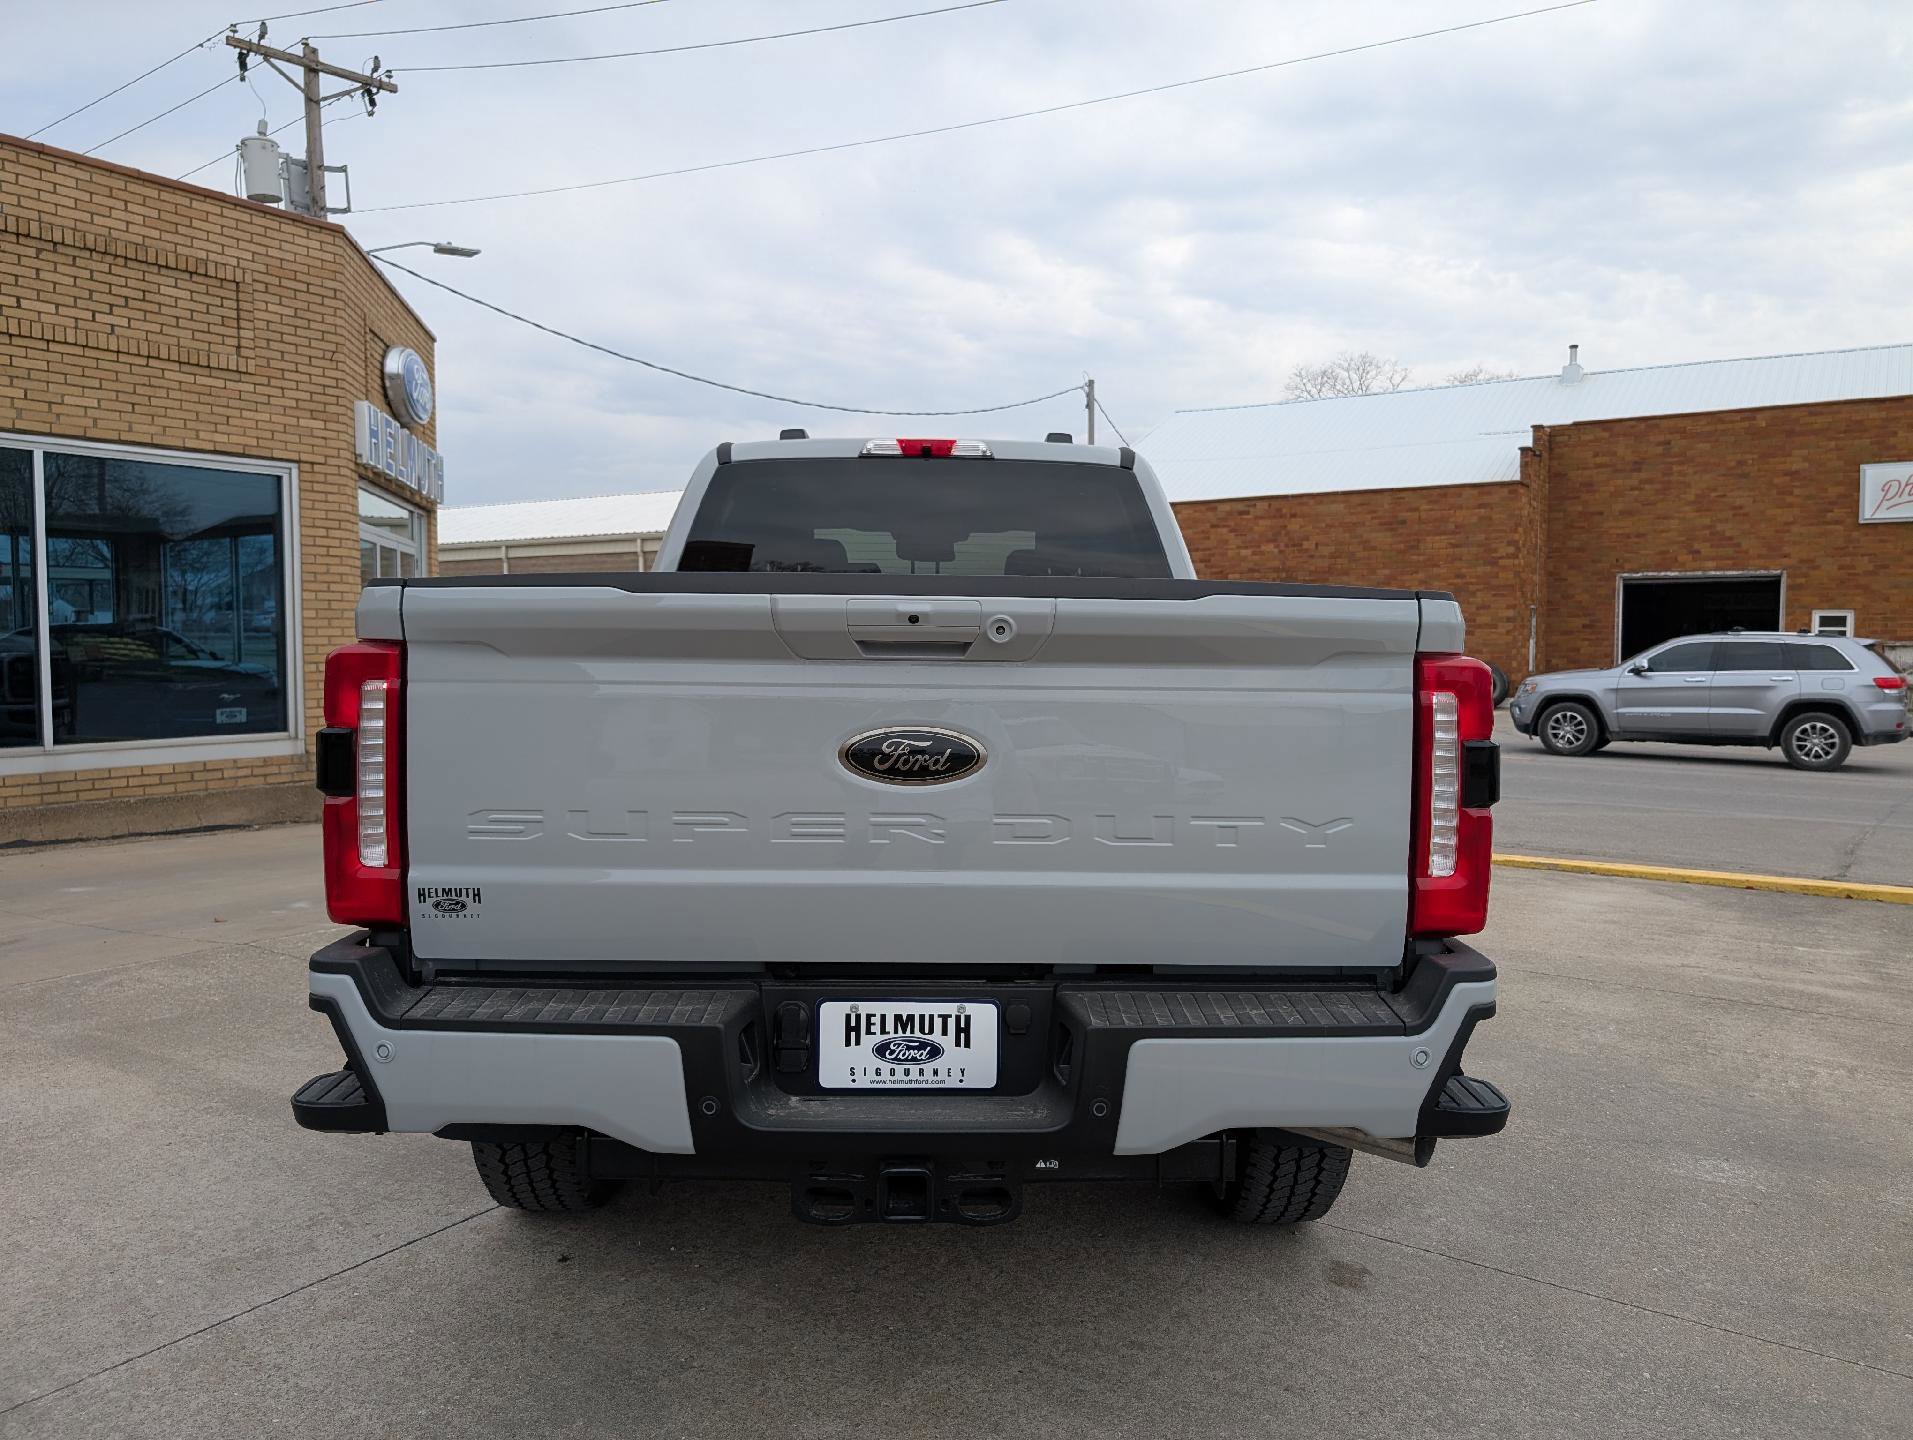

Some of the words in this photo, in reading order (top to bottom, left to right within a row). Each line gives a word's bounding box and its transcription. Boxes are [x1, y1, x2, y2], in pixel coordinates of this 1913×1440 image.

[366, 402, 444, 504] HELMUTH
[873, 738, 952, 771] Ford
[467, 808, 946, 845] SUPER
[993, 812, 1355, 848] DUTY
[417, 887, 482, 905] HELMUTH
[844, 1013, 972, 1049] HELMUTH
[885, 1040, 929, 1060] Ford
[849, 1067, 966, 1078] SIGOURNEY
